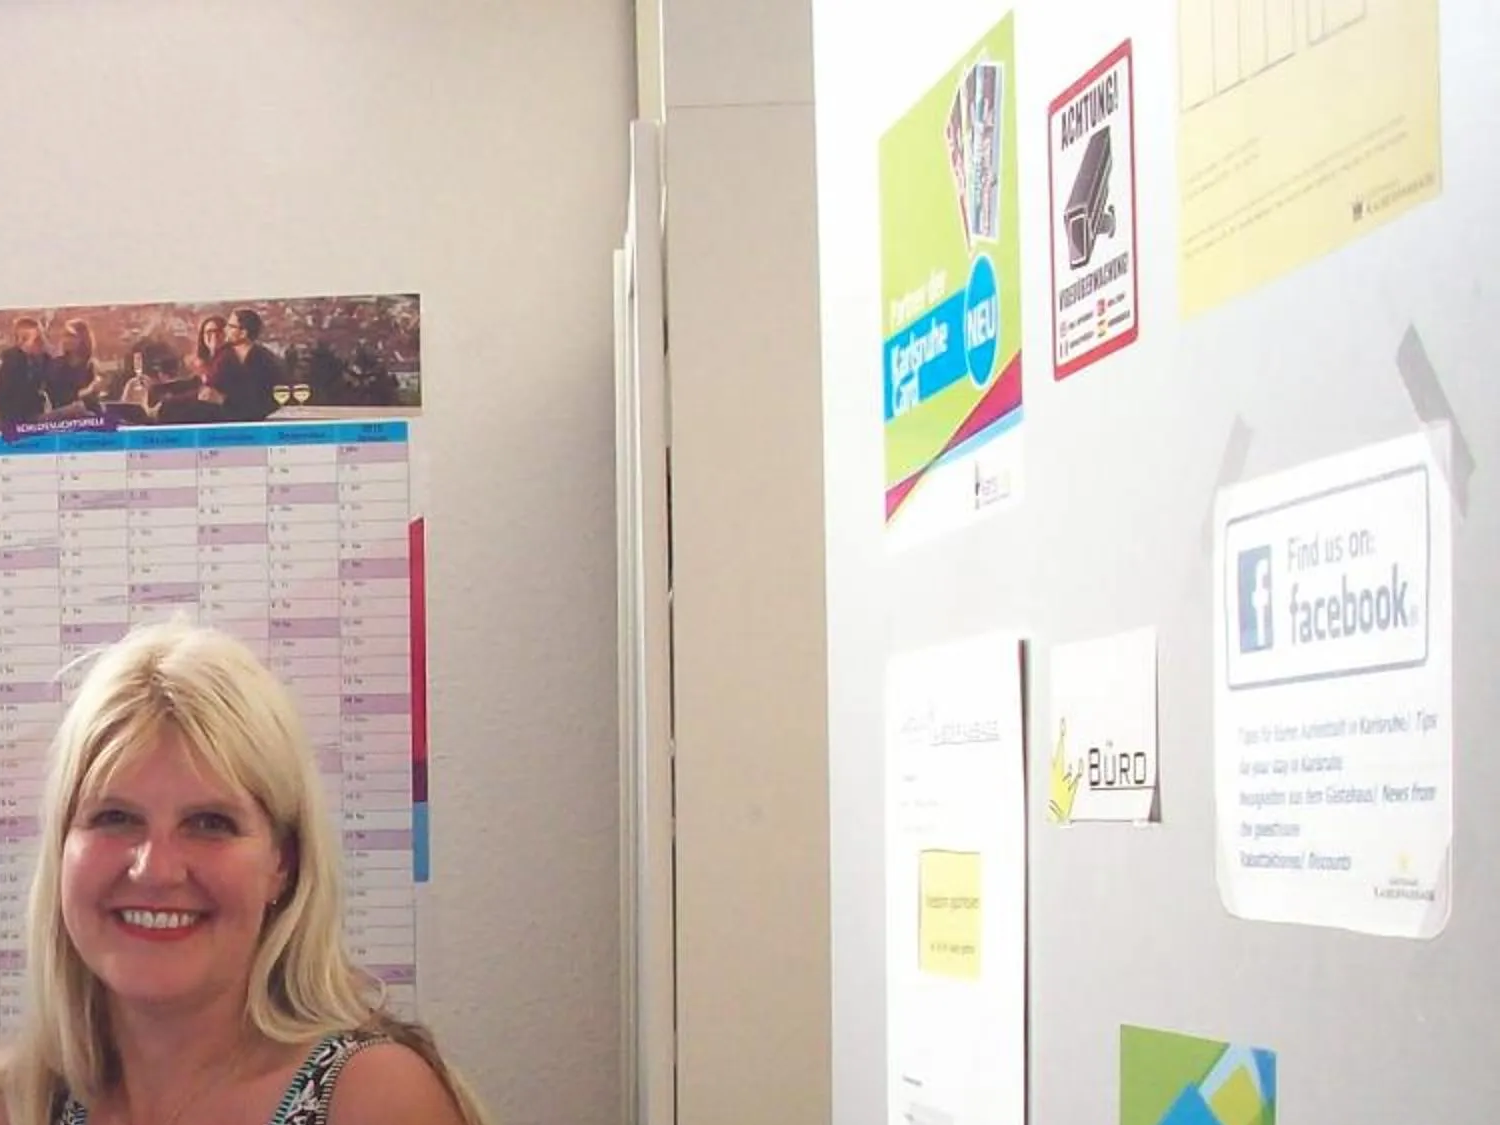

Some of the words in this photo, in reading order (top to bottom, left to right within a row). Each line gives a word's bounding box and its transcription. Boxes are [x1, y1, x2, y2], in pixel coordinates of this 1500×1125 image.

[1061, 70, 1119, 152] ACHTUNG!
[967, 293, 996, 348] NEU
[1287, 532, 1320, 573] Find
[1325, 536, 1343, 563] us
[1088, 740, 1147, 786] BÜRO
